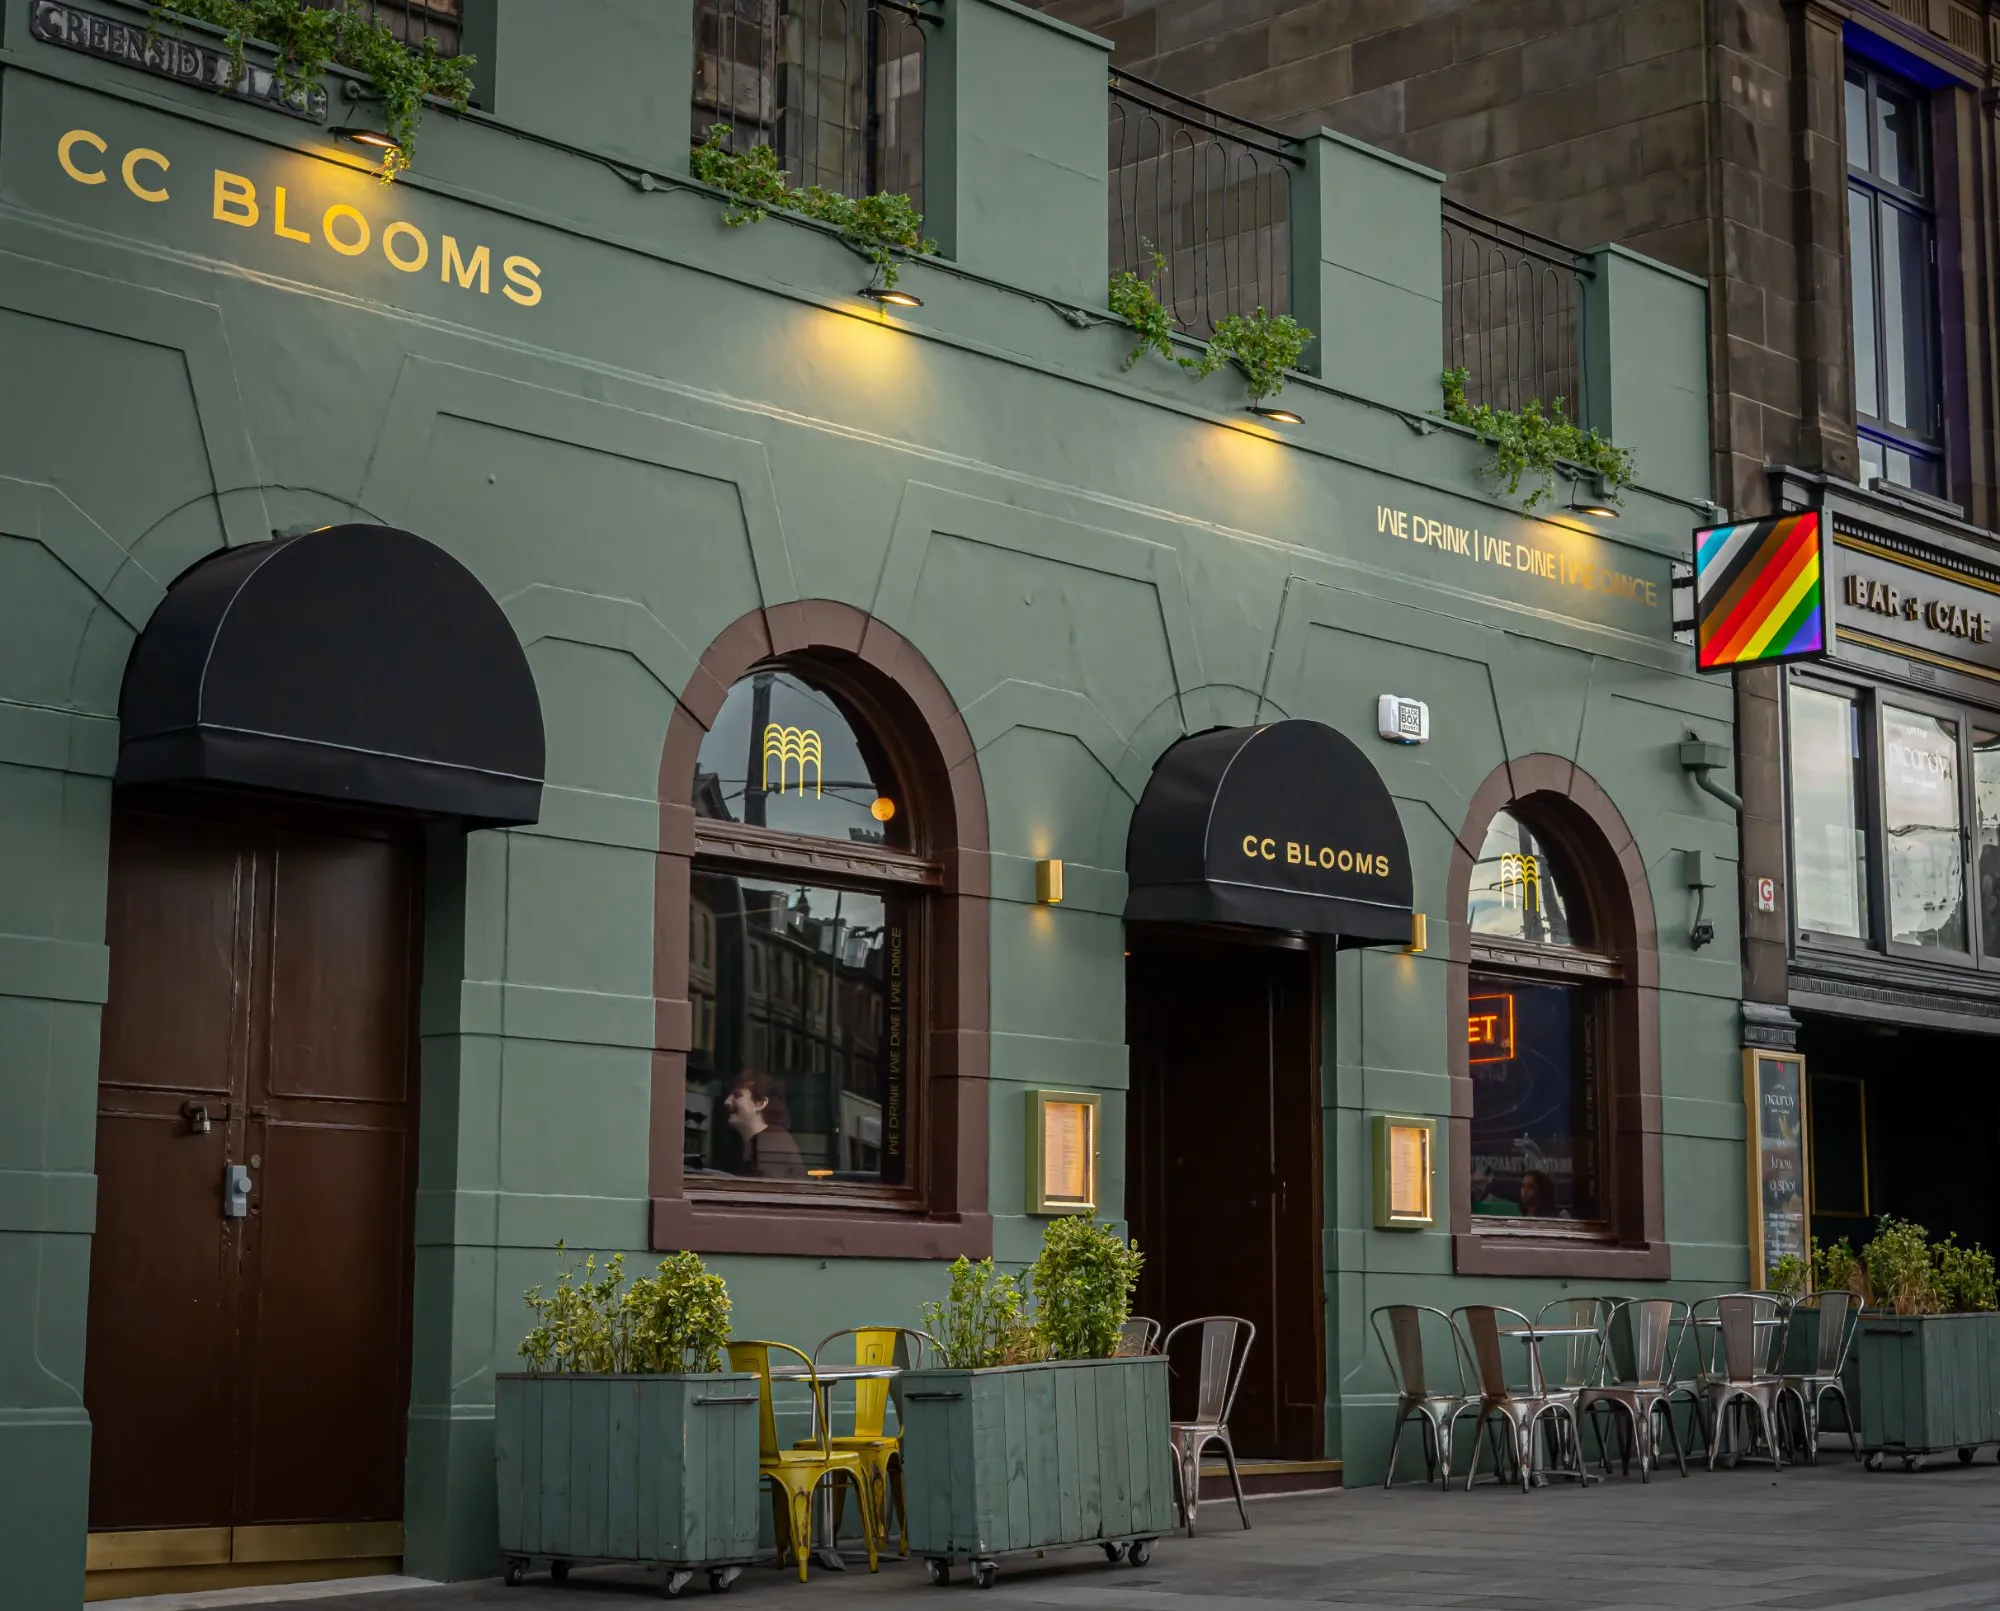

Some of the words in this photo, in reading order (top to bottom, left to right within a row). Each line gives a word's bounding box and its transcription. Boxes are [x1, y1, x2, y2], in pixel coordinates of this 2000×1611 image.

[38, 5, 220, 84] GREENSIDE
[57, 129, 170, 203] CC
[213, 169, 543, 307] BLOOMS
[1377, 505, 1408, 539] WE
[1413, 516, 1470, 557] DRINK
[1484, 535, 1511, 568] WE
[1516, 545, 1555, 580] DINE
[1568, 560, 1596, 591] WE
[1601, 572, 1658, 607] DANCE
[1847, 574, 1900, 617] BAR
[1928, 600, 1992, 643] CAFE
[1401, 713, 1418, 726] BOX
[1888, 740, 1949, 780] picardy
[1242, 835, 1276, 860] CC
[1287, 841, 1390, 877] BLOOMS
[1760, 879, 1773, 902] G
[891, 927, 902, 976] DANCE
[891, 980, 901, 1003] WE
[890, 1014, 900, 1047] DINE
[889, 1049, 900, 1073] WE
[888, 1084, 899, 1129] DRINK
[888, 1131, 899, 1156] WE
[1771, 1155, 1792, 1170] know
